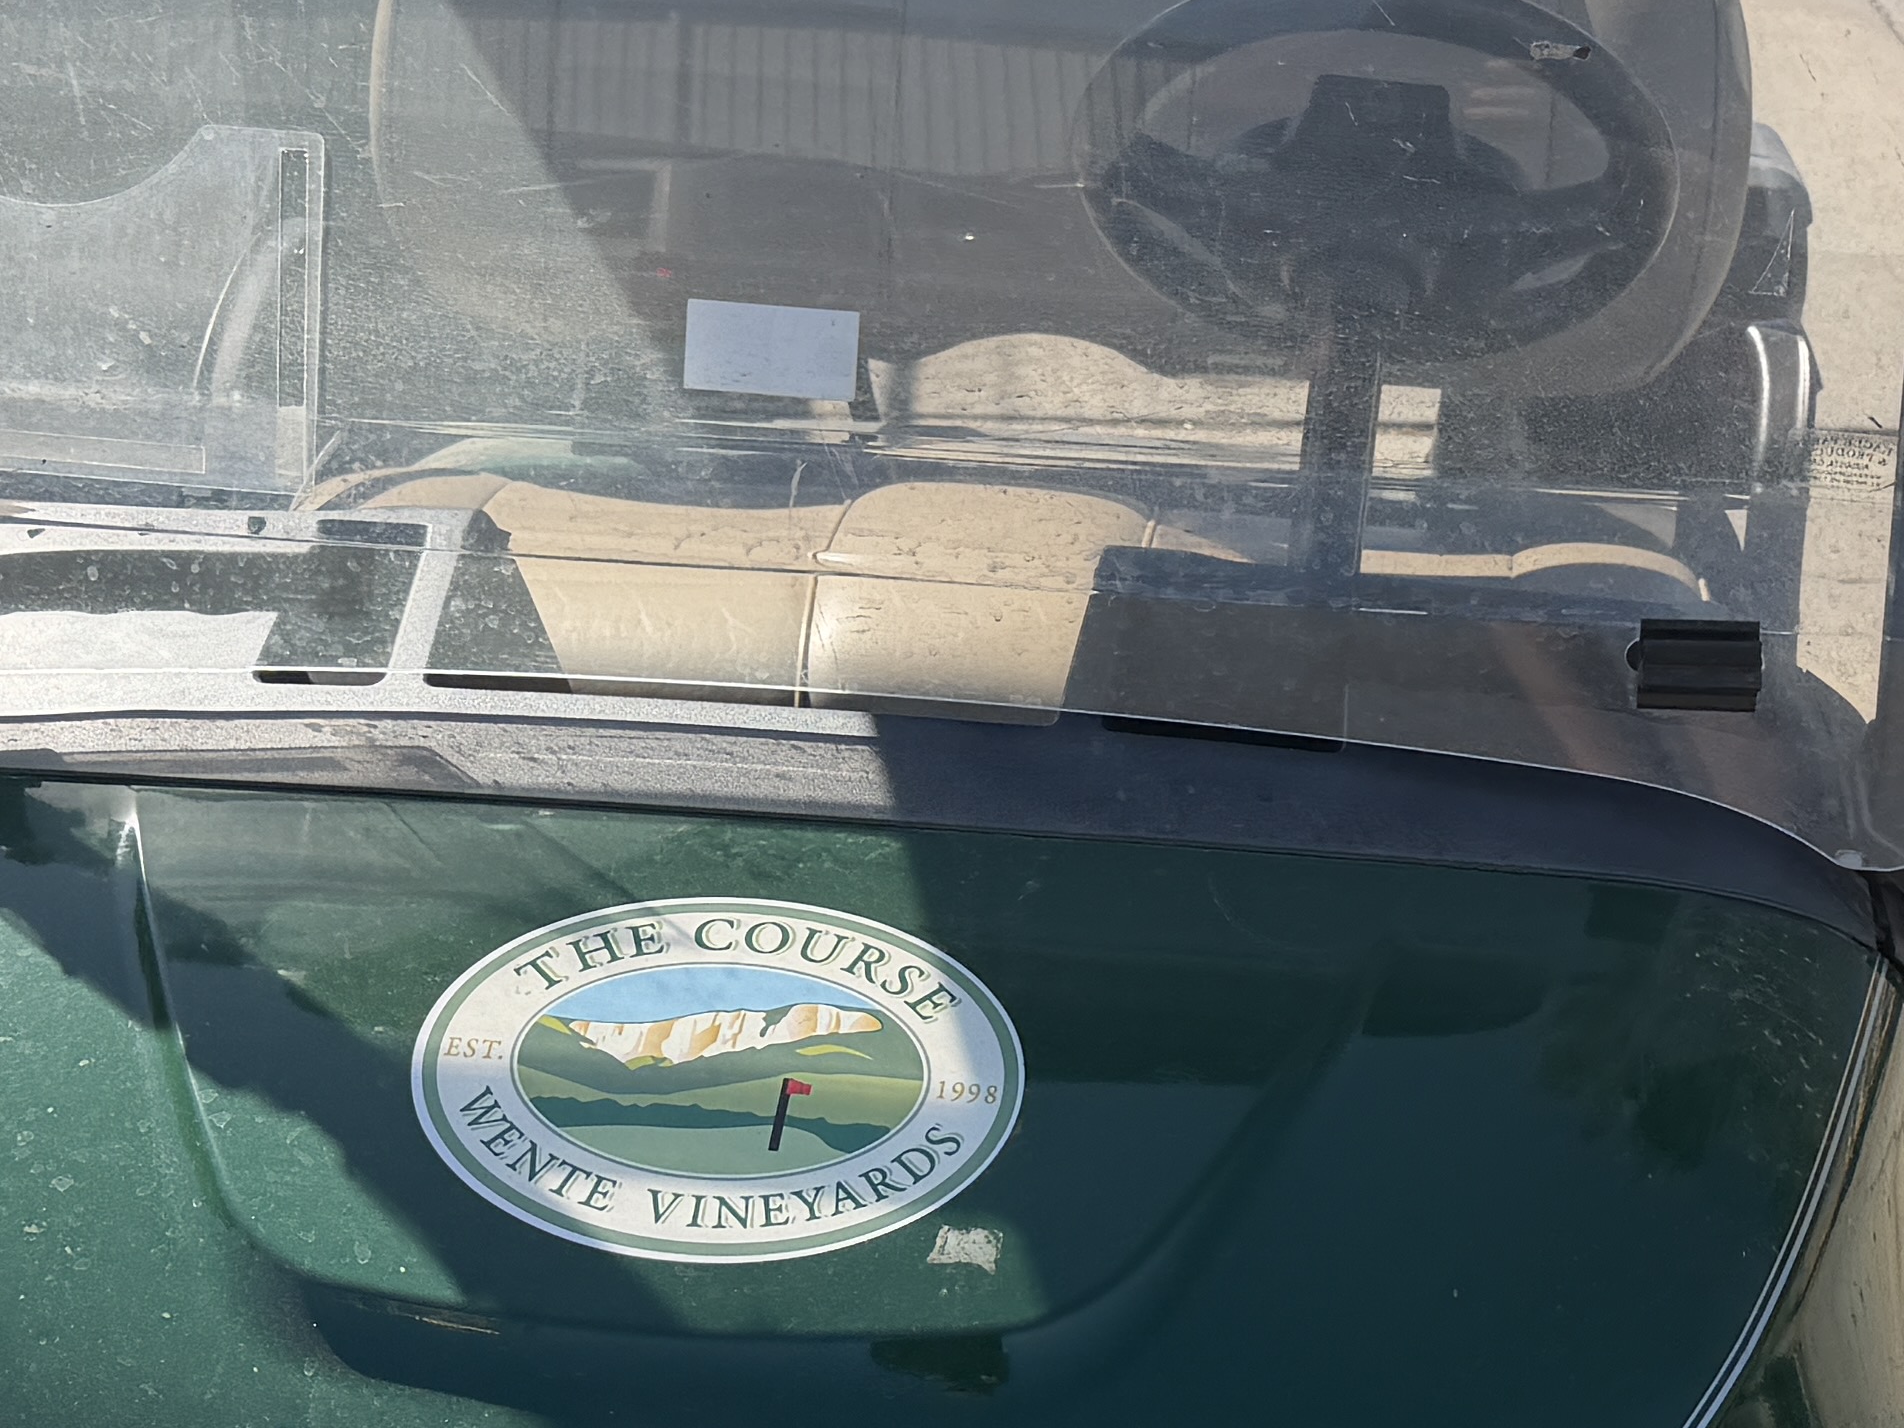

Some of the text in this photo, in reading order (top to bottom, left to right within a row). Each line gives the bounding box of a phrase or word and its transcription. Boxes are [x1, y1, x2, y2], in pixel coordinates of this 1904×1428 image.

[513, 918, 959, 1022] THE COURSE
[443, 1036, 998, 1104] EST. 1998
[459, 1084, 962, 1229] WENTE VINEYARDS
